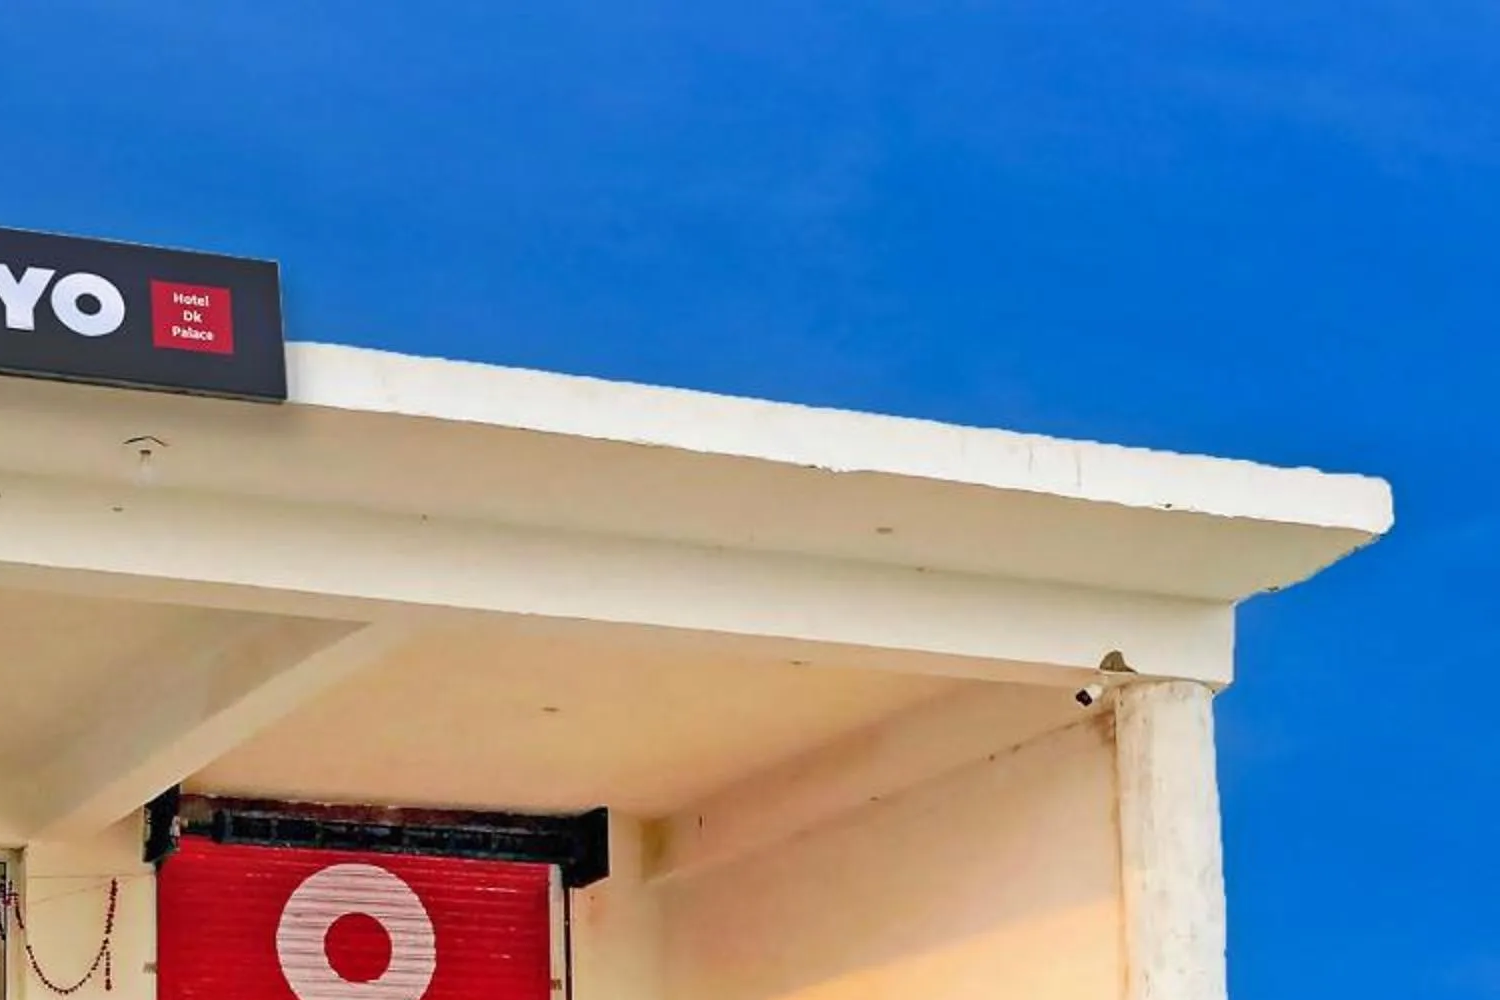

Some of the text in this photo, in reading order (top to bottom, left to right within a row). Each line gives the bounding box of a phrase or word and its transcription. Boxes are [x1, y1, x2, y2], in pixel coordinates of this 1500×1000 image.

[173, 291, 209, 307] Hotel
[183, 310, 203, 323] Dk
[171, 325, 214, 341] Palace
